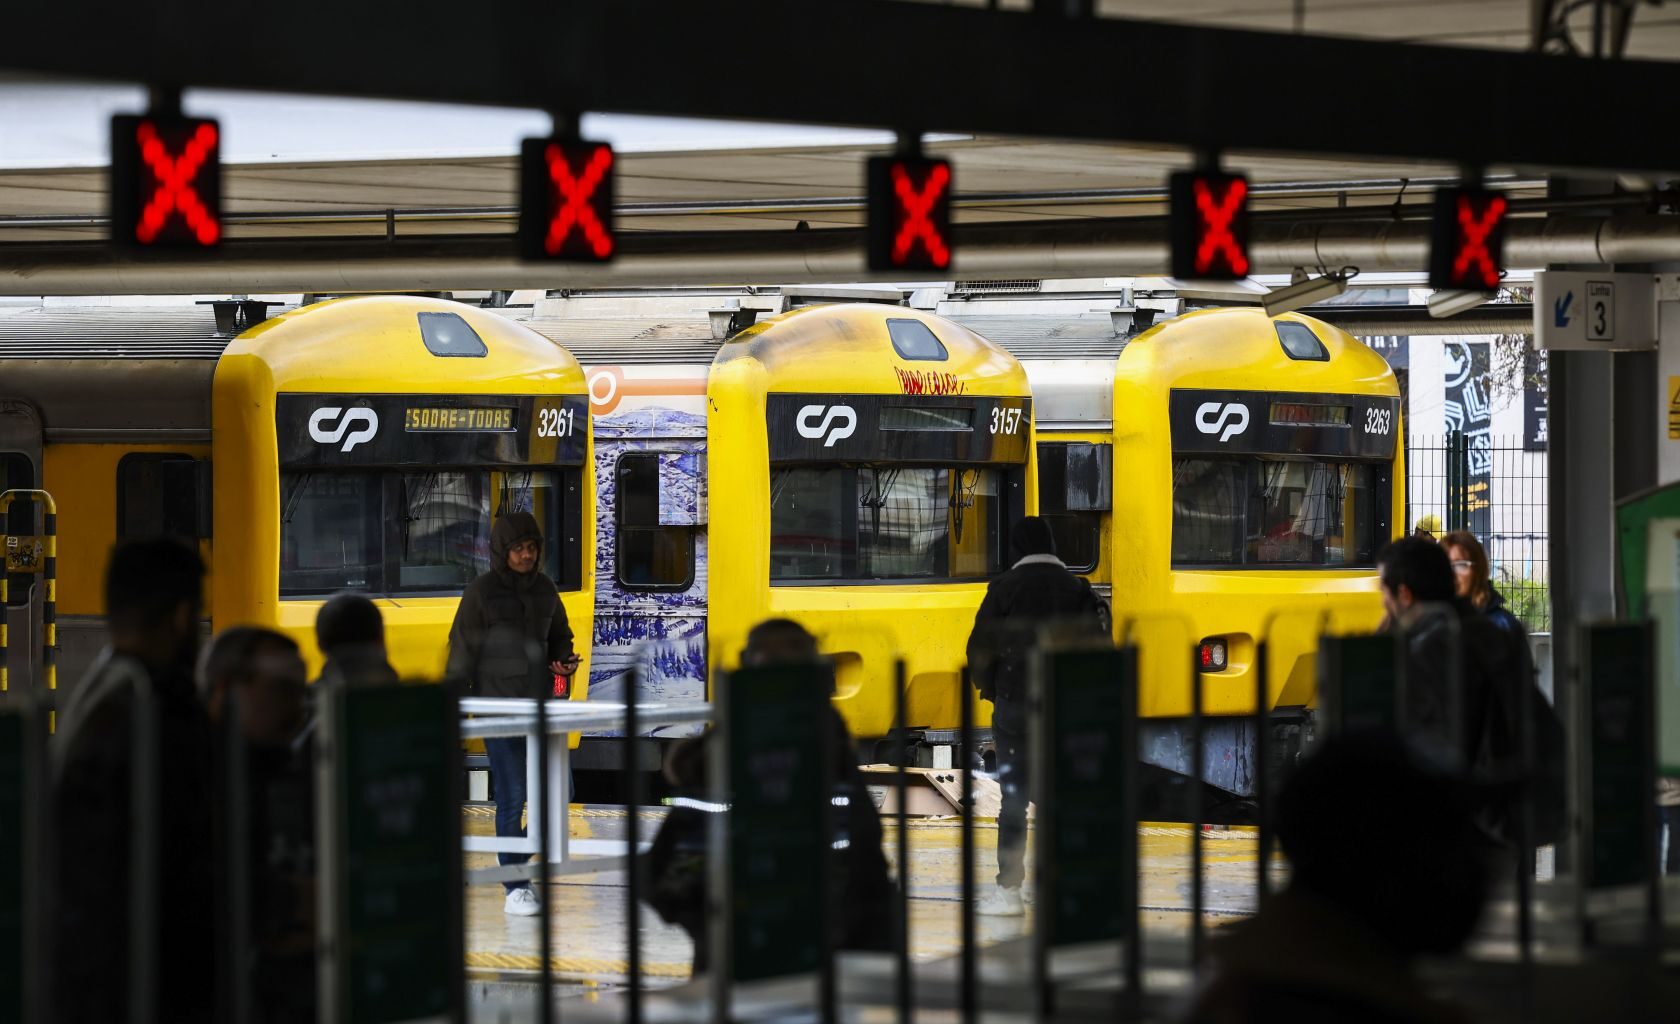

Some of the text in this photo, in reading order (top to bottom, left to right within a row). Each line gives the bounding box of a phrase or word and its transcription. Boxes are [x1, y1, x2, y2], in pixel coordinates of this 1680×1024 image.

[1594, 301, 1607, 337] 3
[308, 407, 379, 452] CP
[537, 408, 575, 438] 3261
[796, 405, 858, 447] CP
[989, 407, 1022, 436] 3157
[1195, 402, 1250, 442] CP
[1364, 407, 1391, 435] 3263
